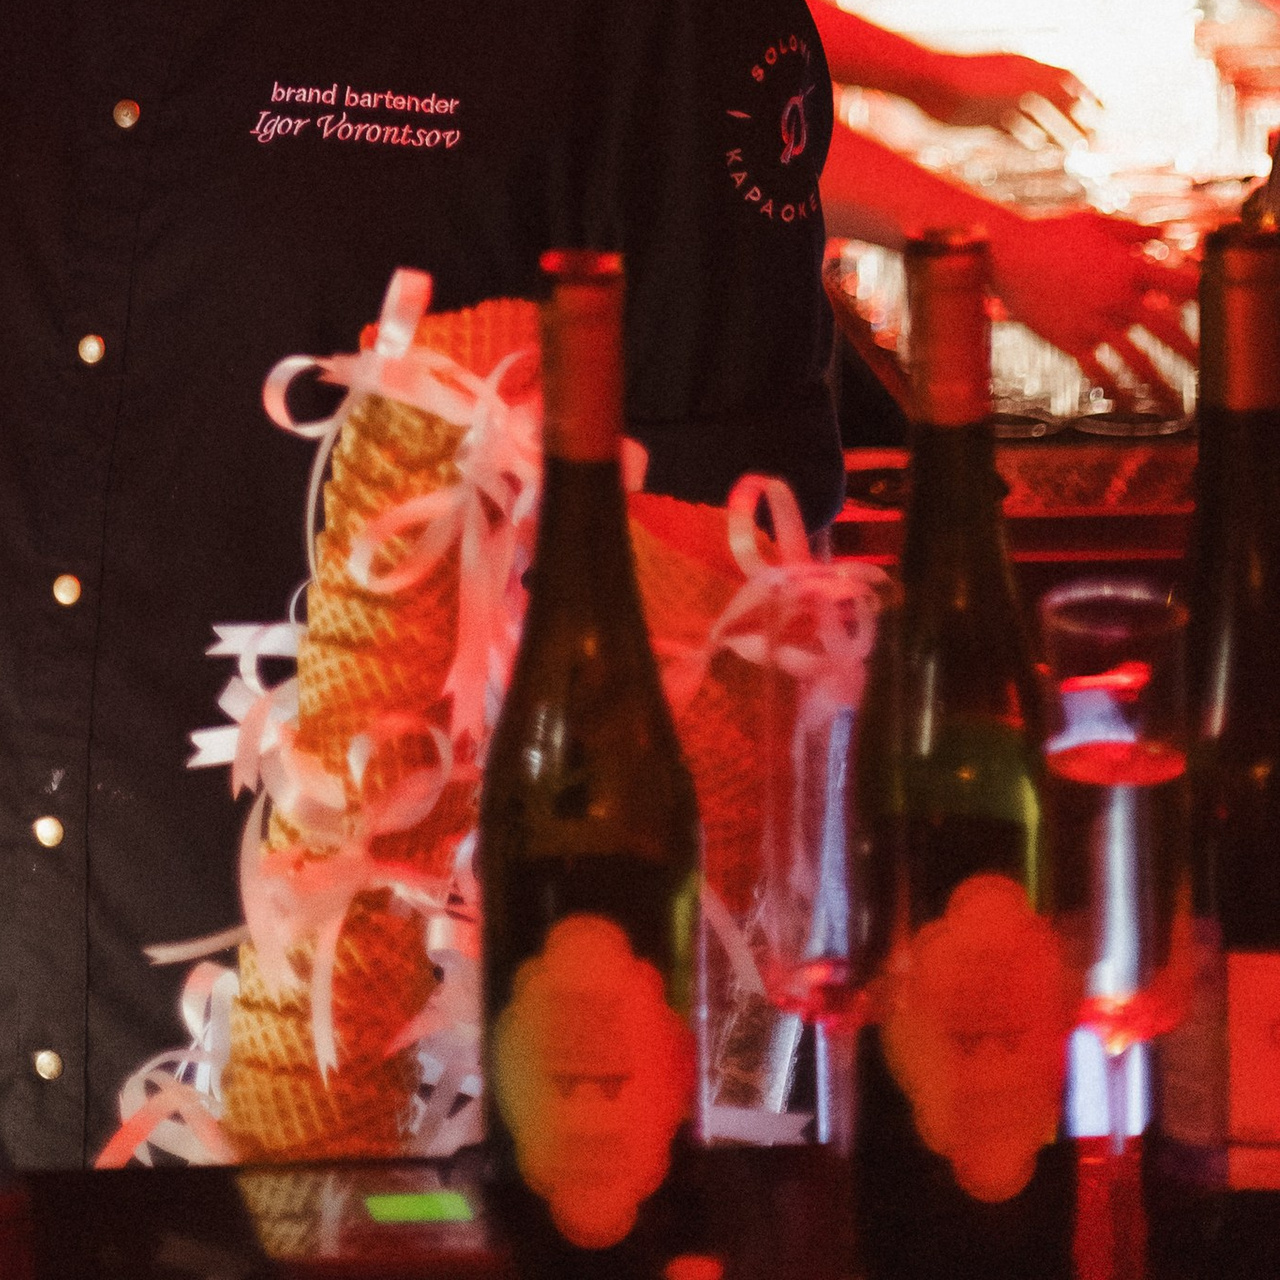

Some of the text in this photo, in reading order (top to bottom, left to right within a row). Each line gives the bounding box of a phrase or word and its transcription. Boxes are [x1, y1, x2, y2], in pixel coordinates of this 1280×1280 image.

[271, 81, 460, 115] brand bartender
[249, 110, 461, 149] Igor Vorontsov
